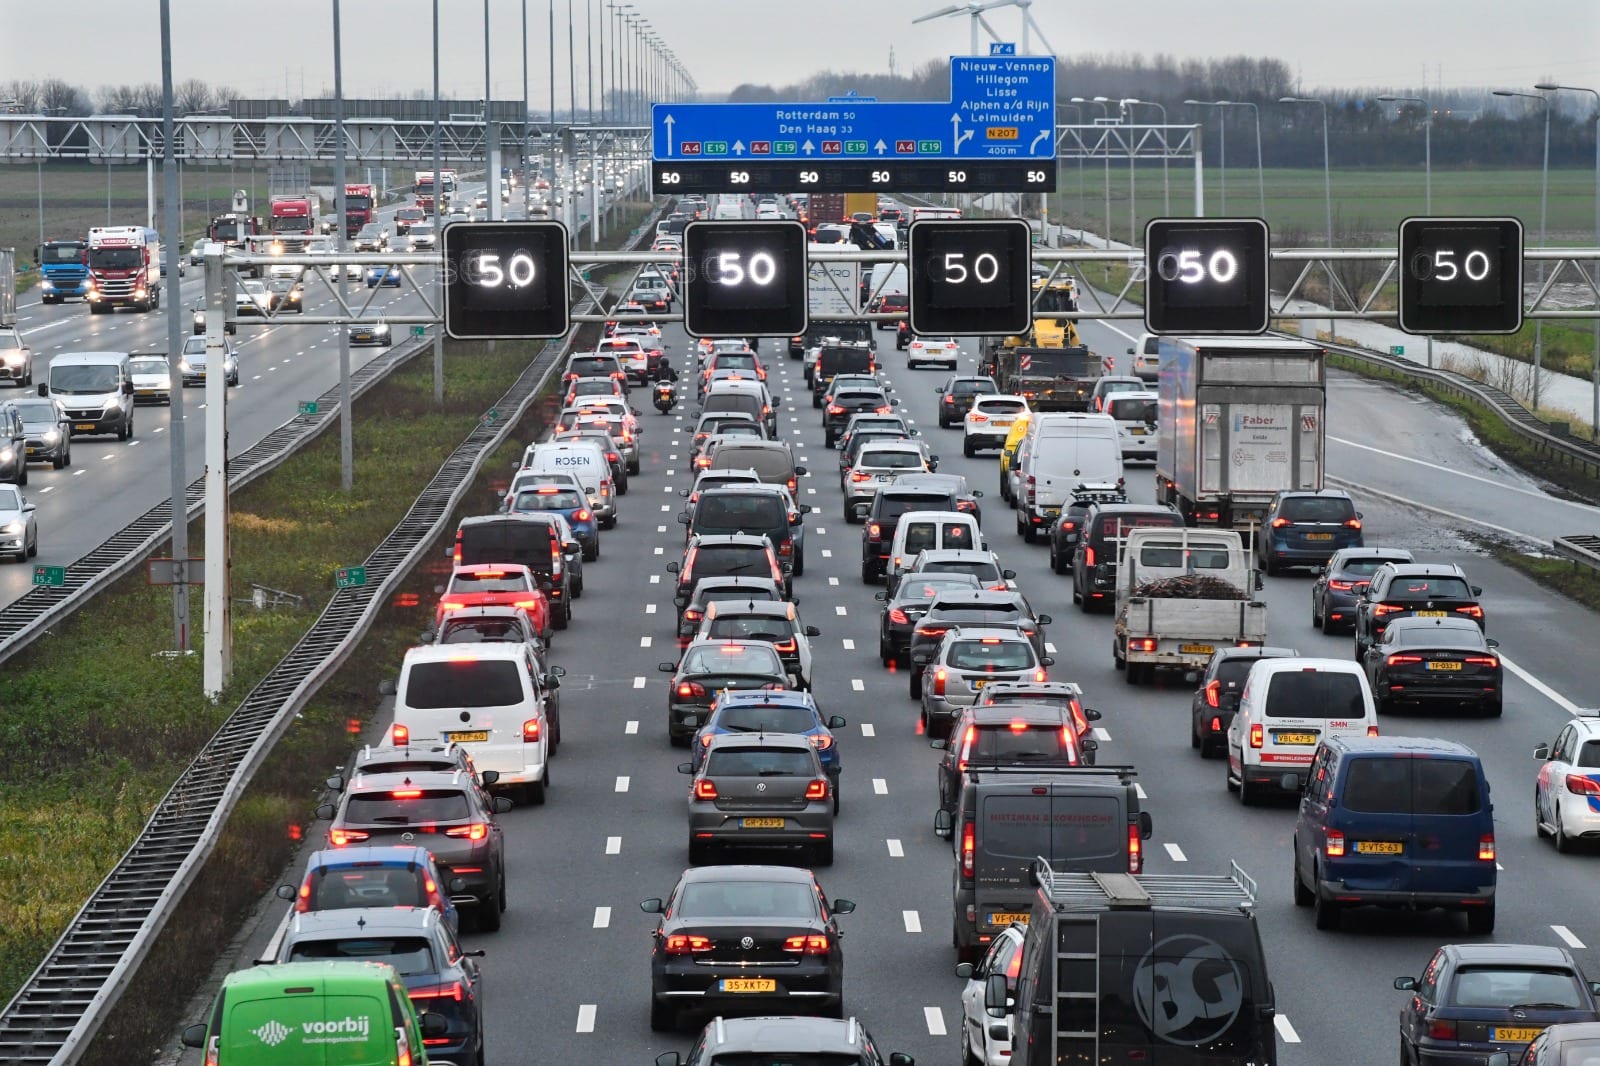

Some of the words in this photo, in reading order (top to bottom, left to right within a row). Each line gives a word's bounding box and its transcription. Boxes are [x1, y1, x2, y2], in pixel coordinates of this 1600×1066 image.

[1005, 45, 1012, 53] 4
[960, 62, 1050, 72] Nieuw-Vennep
[976, 75, 1029, 86] Hillegom
[986, 87, 1018, 97] Lisse
[960, 100, 1000, 111] Alphen
[1003, 100, 1023, 110] a/d
[1027, 100, 1049, 112] Rijn
[776, 111, 839, 120] Rotterdam
[843, 112, 856, 120] 50
[971, 113, 1034, 122] Leimuiden
[779, 124, 802, 134] Den
[807, 124, 837, 136] Haag
[840, 126, 853, 134] 33
[988, 147, 1007, 155] 400
[661, 172, 680, 184] 50
[730, 171, 750, 184] 50
[799, 171, 819, 183] 50
[871, 171, 890, 183] 50
[948, 171, 967, 183] 50
[1027, 171, 1046, 183] 50
[479, 255, 535, 287] 50
[719, 253, 776, 286] 50
[945, 253, 999, 284] 50
[1178, 250, 1237, 283] 50
[1434, 251, 1490, 281] 50
[1242, 415, 1274, 425] Faber
[555, 456, 590, 466] ROSEN
[1360, 843, 1398, 852] 3-VTS-63
[994, 914, 1030, 923] VF-044-
[728, 980, 771, 990] 35-XKT-7
[302, 1016, 369, 1036] voorbij
[1499, 1029, 1541, 1040] SV-JJ-6
